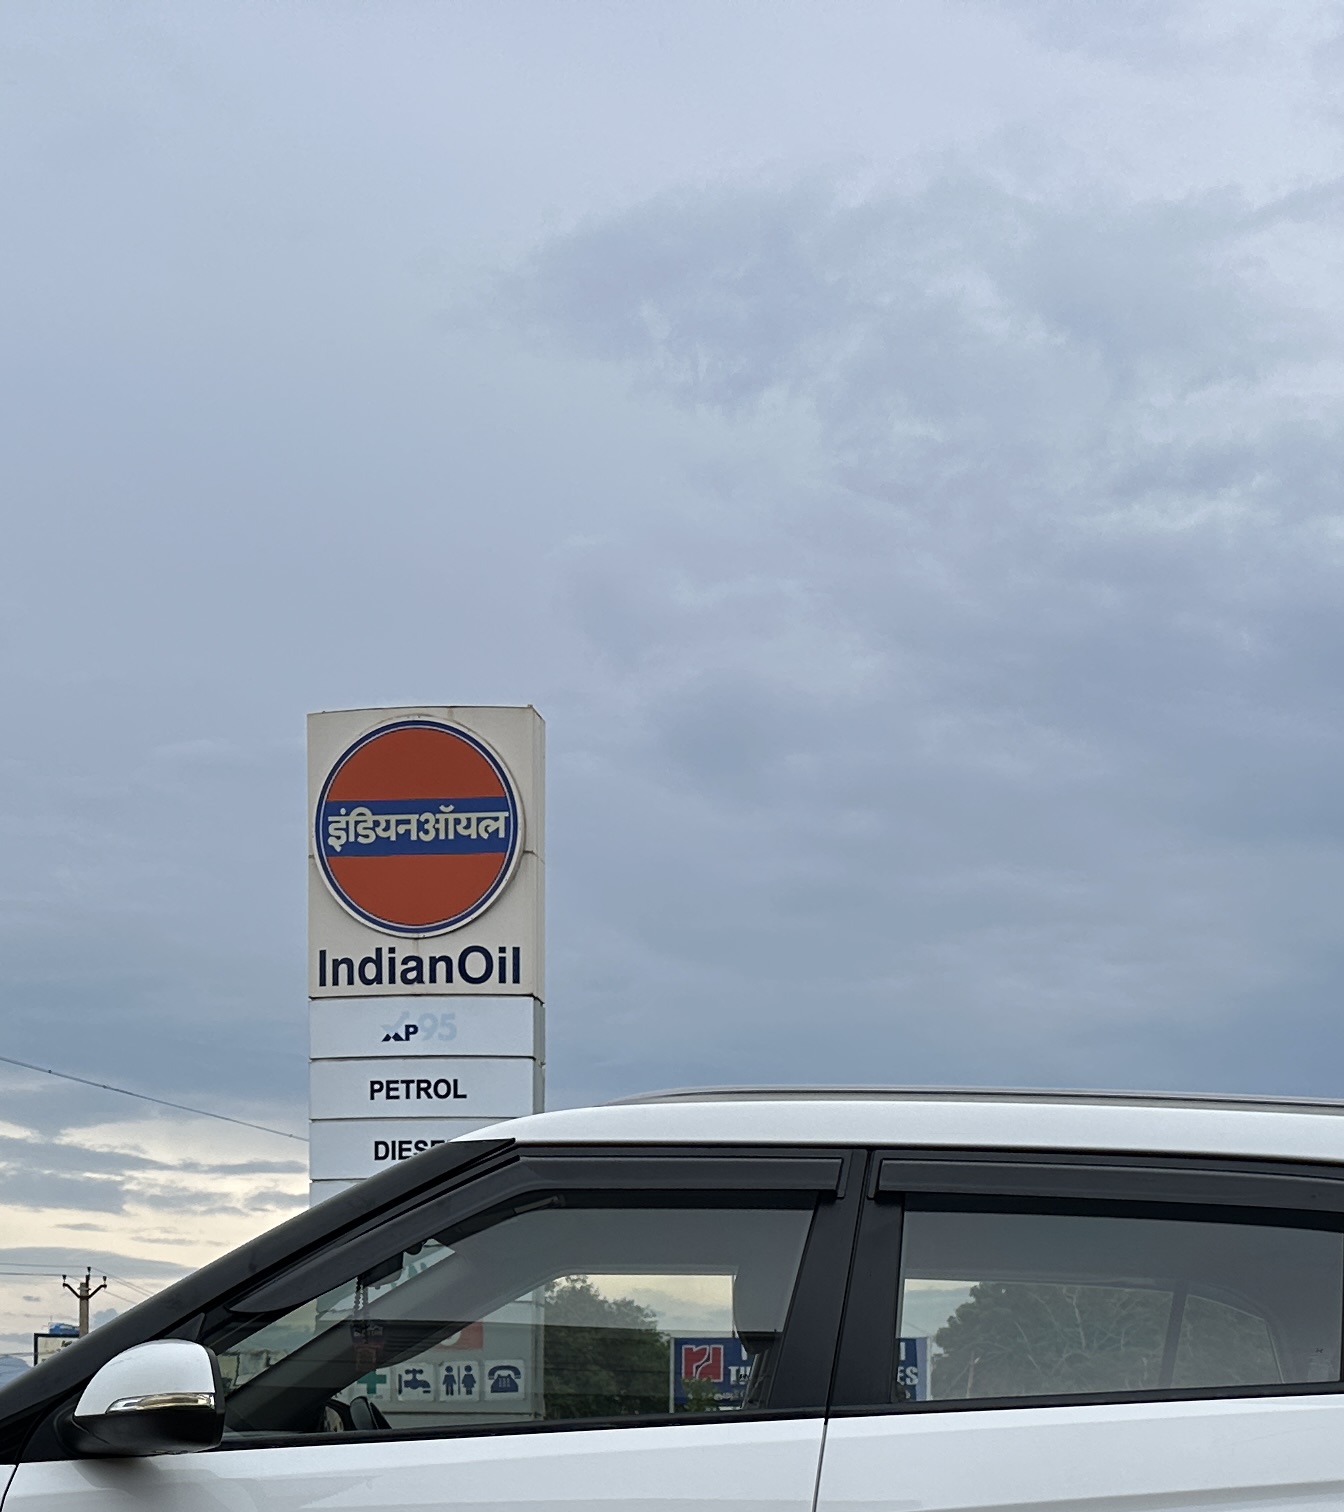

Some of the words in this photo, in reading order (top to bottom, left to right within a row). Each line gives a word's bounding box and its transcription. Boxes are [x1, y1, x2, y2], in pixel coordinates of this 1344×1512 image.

[327, 804, 509, 852] इंडियनऑयल
[318, 947, 522, 987] IndianOil
[369, 1079, 468, 1101] PETROL
